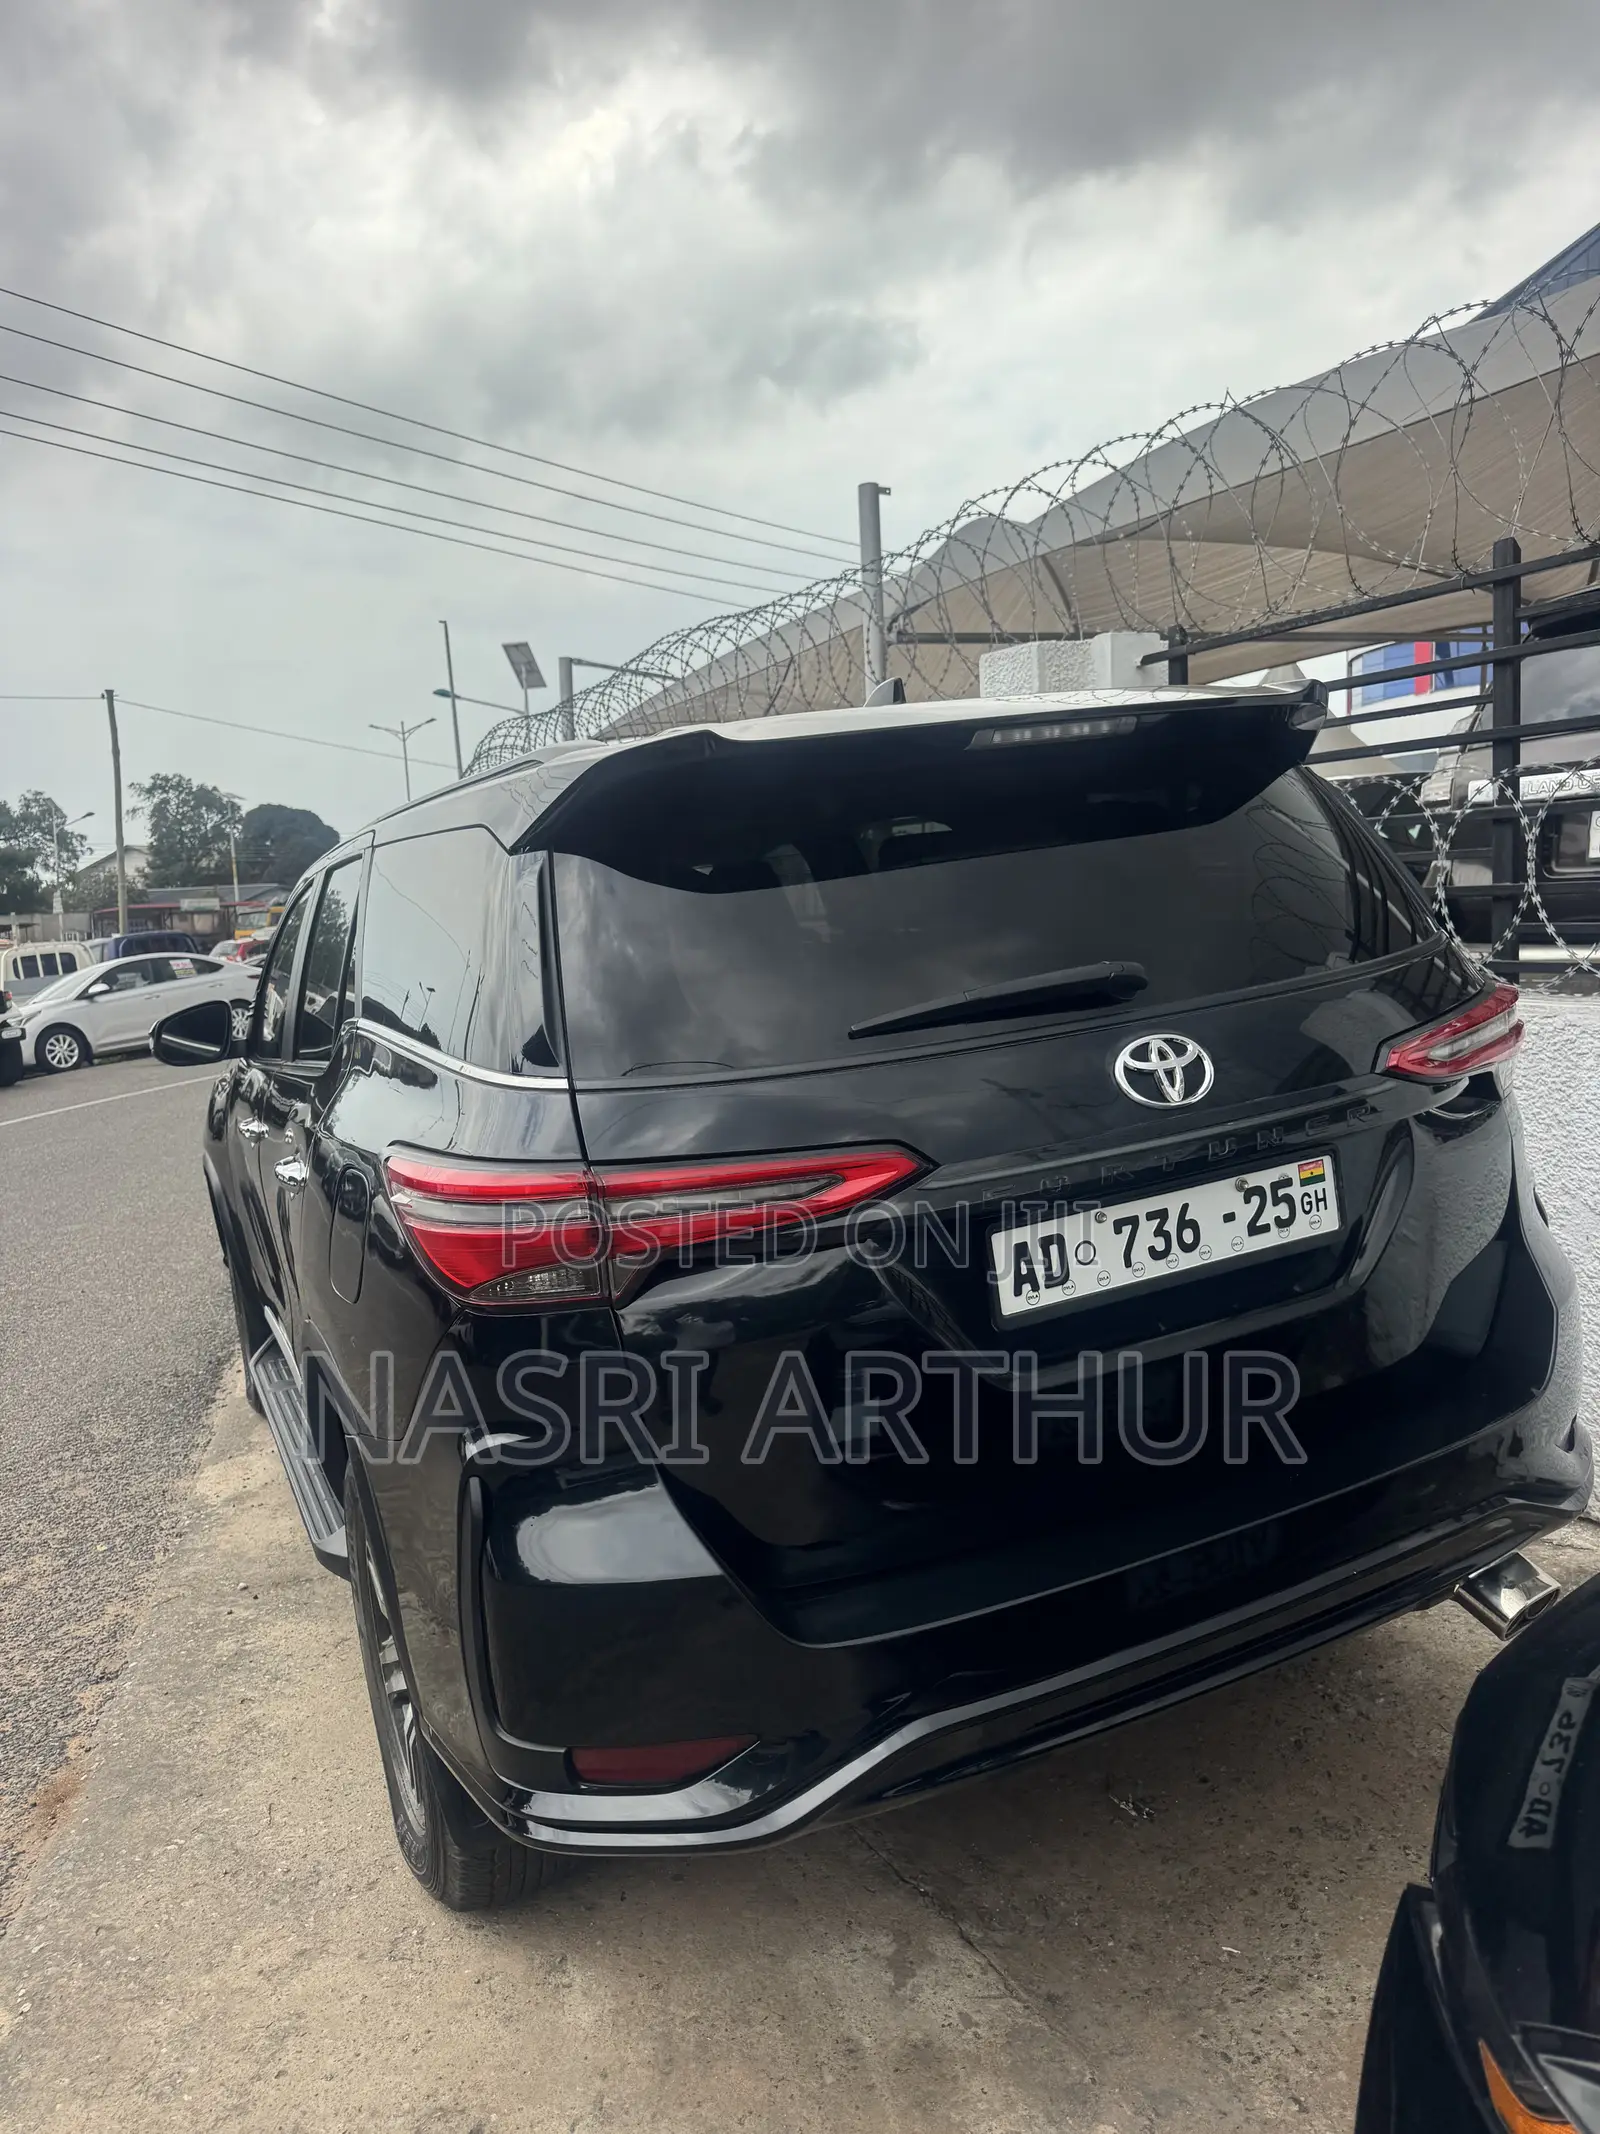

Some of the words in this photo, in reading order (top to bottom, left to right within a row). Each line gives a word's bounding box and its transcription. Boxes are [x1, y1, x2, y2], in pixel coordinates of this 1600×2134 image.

[1301, 1188, 1327, 1215] GH
[1013, 1233, 1070, 1297] AD
[1113, 1203, 1201, 1268] 736
